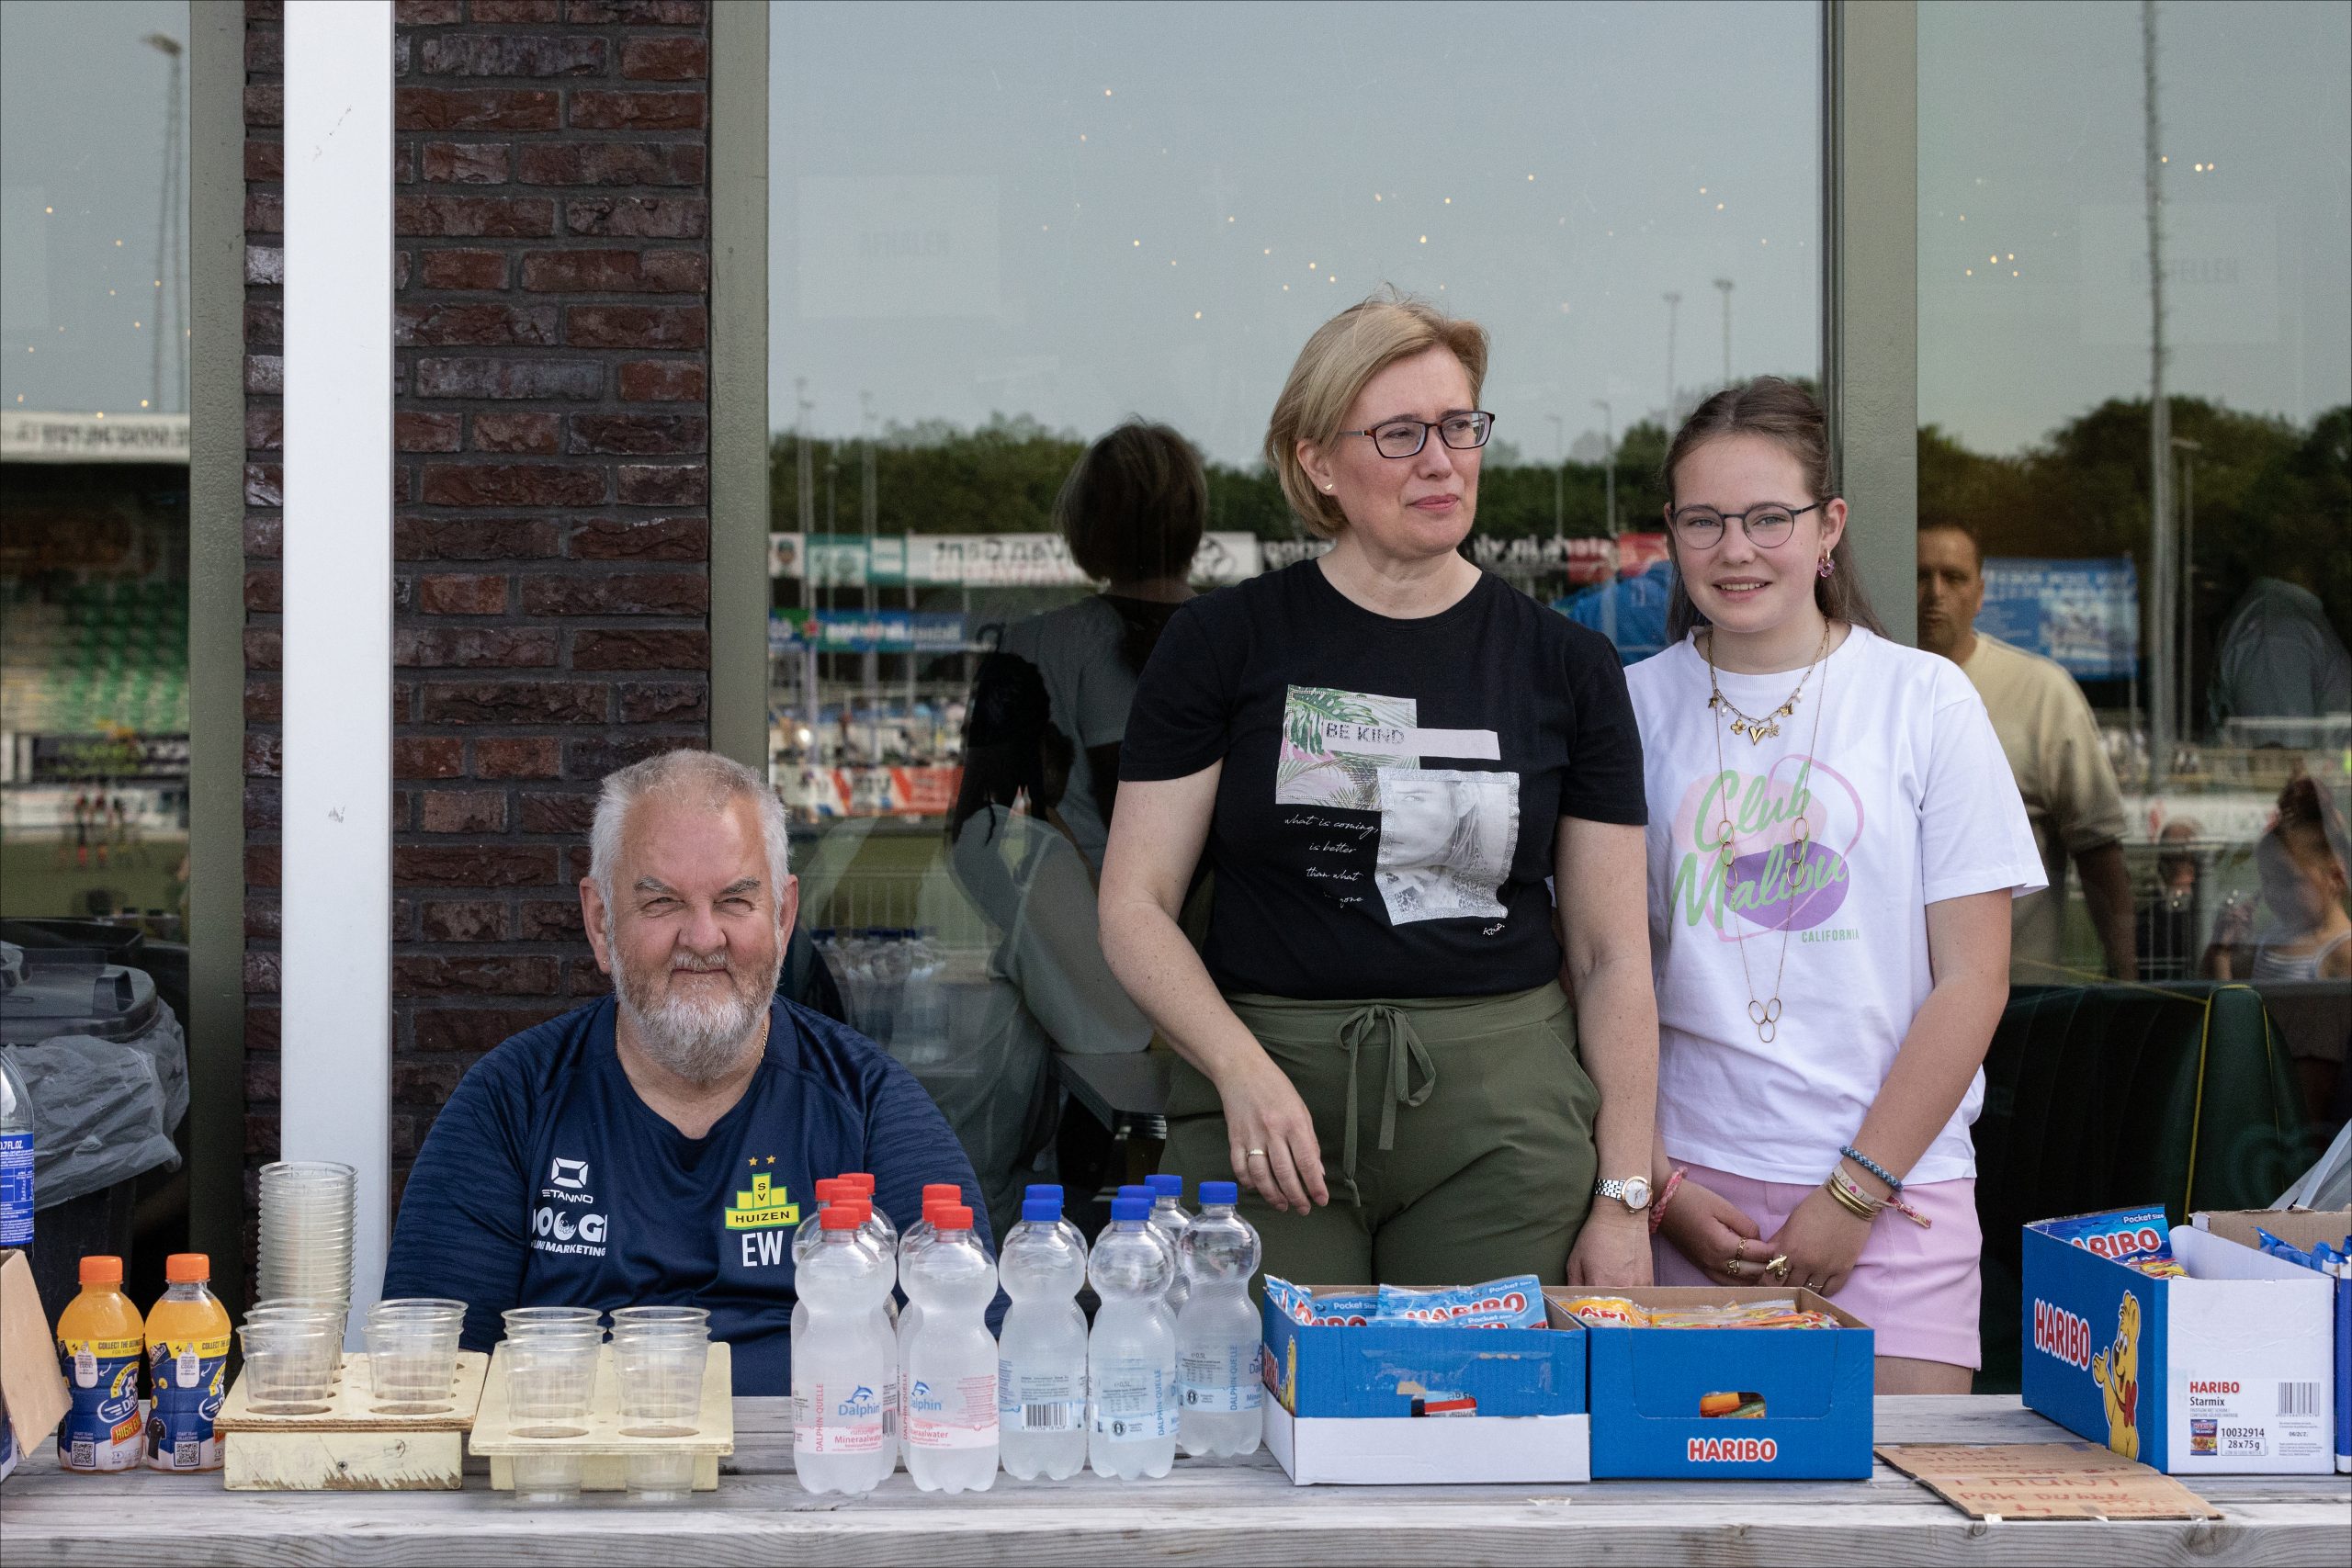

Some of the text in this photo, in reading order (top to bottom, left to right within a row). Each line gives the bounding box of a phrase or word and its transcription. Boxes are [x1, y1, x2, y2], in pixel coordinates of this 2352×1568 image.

[1326, 723, 1405, 745] BE KIND
[1284, 814, 1319, 826] what
[1318, 818, 1331, 827] is
[1309, 840, 1357, 853] is better
[1668, 761, 1849, 943] Club Malibu
[1306, 866, 1364, 882] than what
[1802, 928, 1860, 943] CALIFORNIA
[735, 1211, 790, 1223] HUIZEN
[2123, 1213, 2152, 1224] Pocket
[545, 1241, 606, 1257] MARKETING
[741, 1230, 784, 1267] EW
[2072, 1227, 2161, 1258] RIBO
[1488, 1282, 1519, 1294] Pocket
[1333, 1302, 1363, 1310] Pocket
[1467, 1314, 1498, 1324] Pocket
[2035, 1298, 2091, 1371] HARIBO
[98, 1341, 119, 1349] COLLECT
[202, 1341, 220, 1349] COLLECT
[2190, 1382, 2240, 1393] HARIBO
[910, 1398, 942, 1412] alphin
[2190, 1396, 2225, 1406] Starmix
[838, 1403, 880, 1418] Dalphin
[116, 1424, 132, 1440] HIGH
[2222, 1427, 2265, 1438] 10032914
[1688, 1438, 1777, 1461] HARIBO
